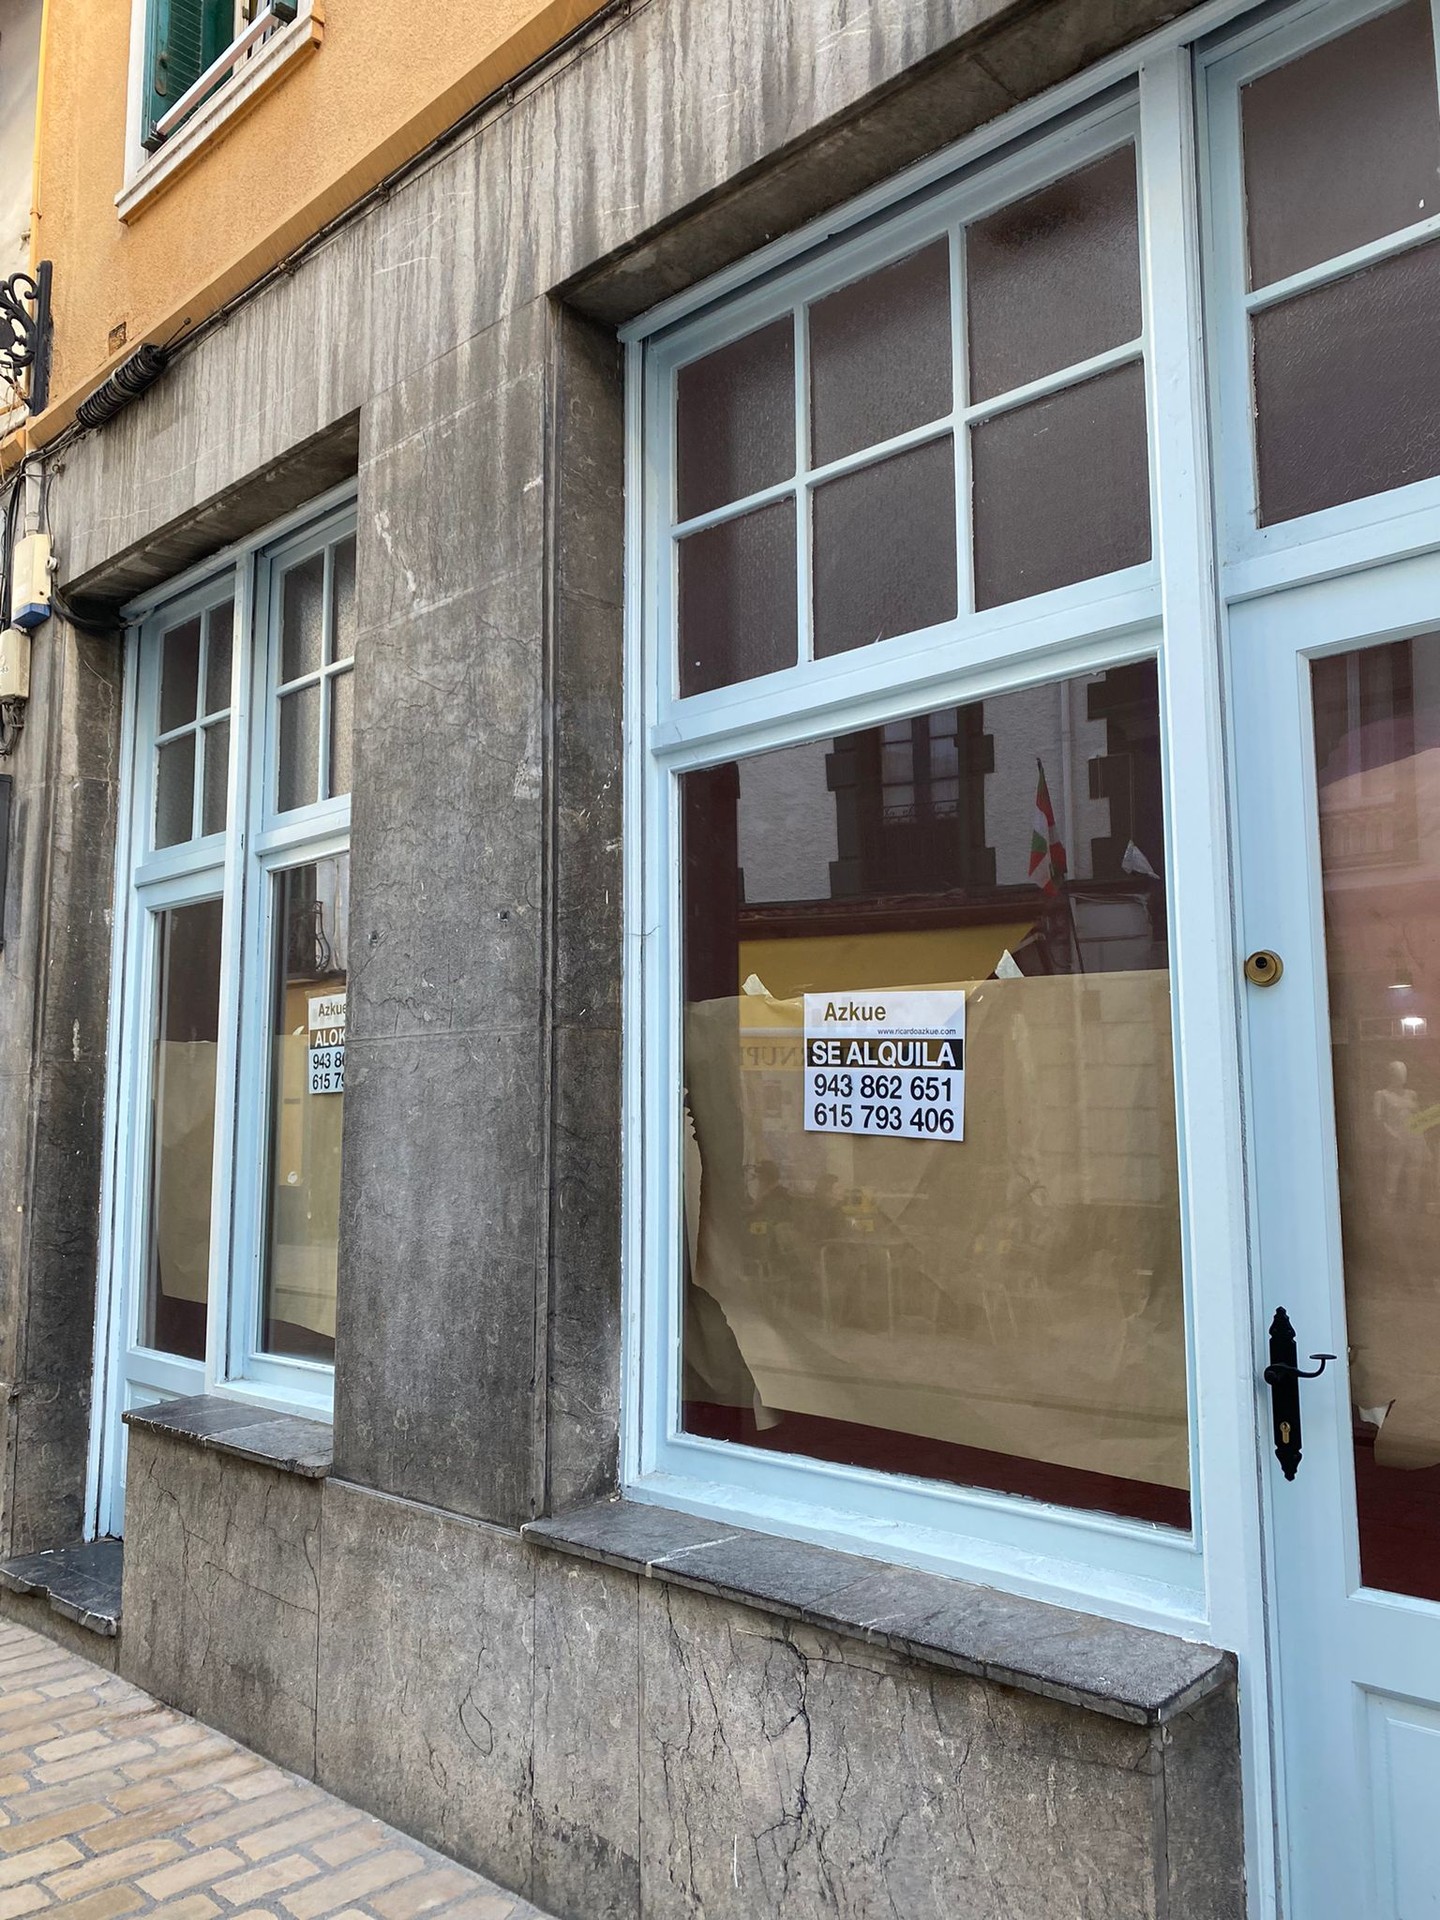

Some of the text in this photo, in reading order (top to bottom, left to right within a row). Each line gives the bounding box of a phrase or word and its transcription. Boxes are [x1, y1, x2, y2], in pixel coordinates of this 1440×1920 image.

[824, 1002, 886, 1021] Azkue
[877, 1028, 956, 1036] www.ricardoazkue.com
[313, 1052, 331, 1070] 943
[812, 1041, 956, 1067] SE ALQUILA
[312, 1073, 330, 1090] 615
[814, 1073, 952, 1102] 943 862 651
[814, 1102, 954, 1134] 615 793 406
